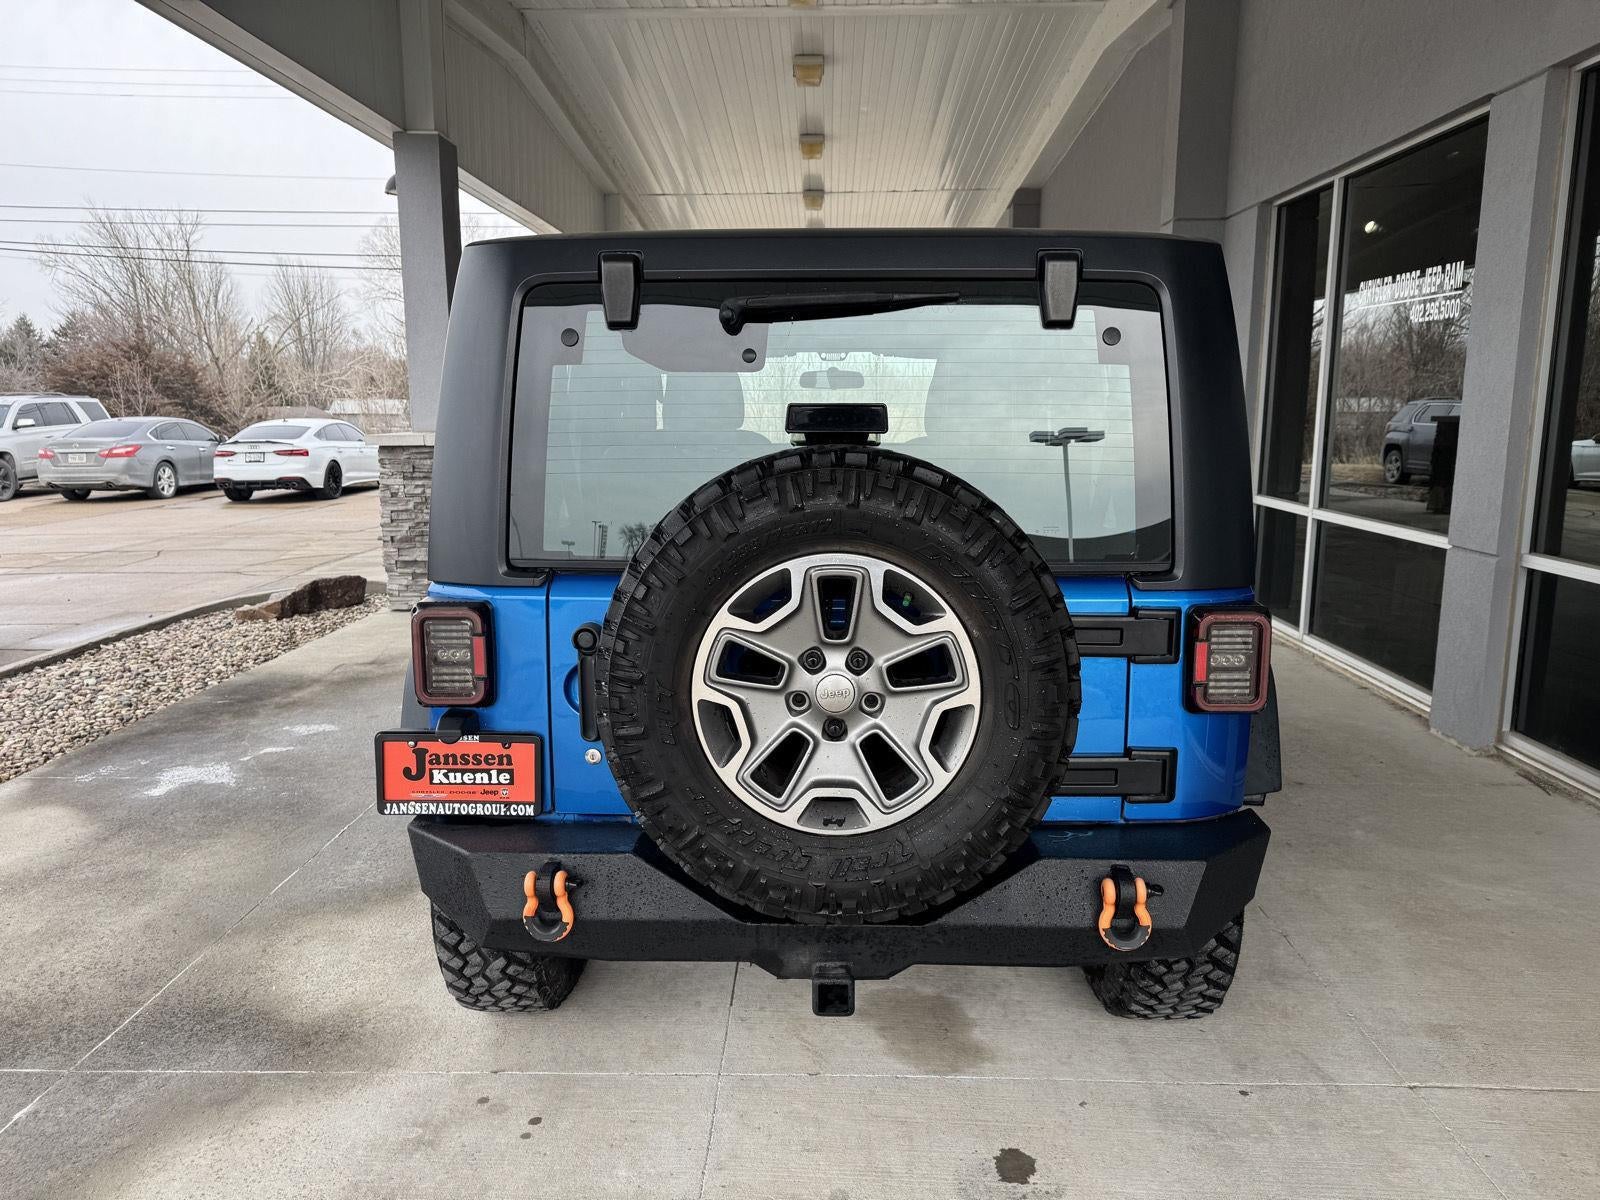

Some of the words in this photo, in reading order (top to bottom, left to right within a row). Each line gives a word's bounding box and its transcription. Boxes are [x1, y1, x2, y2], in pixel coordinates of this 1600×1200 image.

[820, 688, 850, 700] Jeep
[402, 747, 513, 781] Janssen
[431, 769, 511, 784] Kuenle
[480, 788, 499, 796] Jeep
